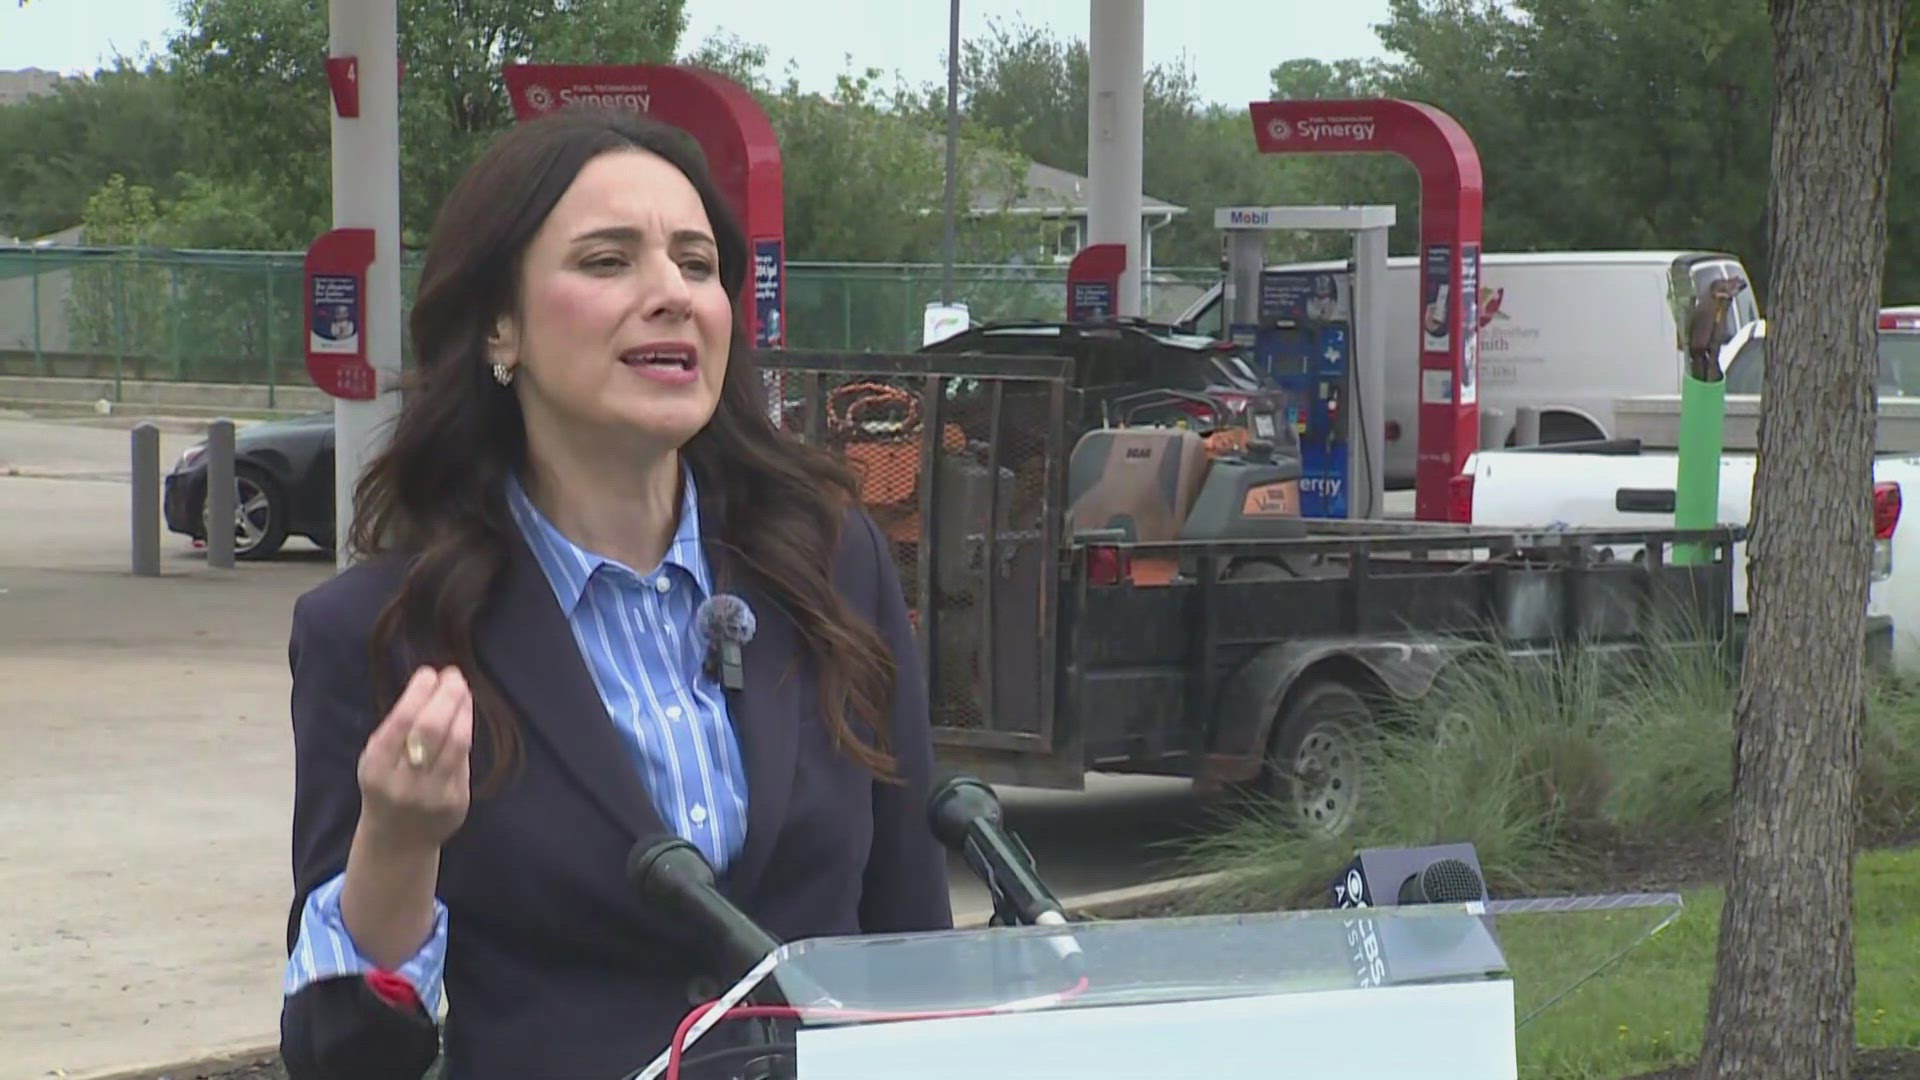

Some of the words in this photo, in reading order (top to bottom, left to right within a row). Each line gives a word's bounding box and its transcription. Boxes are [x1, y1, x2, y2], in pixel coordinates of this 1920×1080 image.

[347, 63, 355, 82] 4
[573, 84, 592, 92] FUEL
[560, 88, 650, 112] Synergy
[1297, 120, 1376, 142] Synergy
[1231, 211, 1269, 225] Mobil
[1336, 331, 1344, 341] 2
[1300, 478, 1342, 498] ergy
[1357, 901, 1386, 986] CBS
